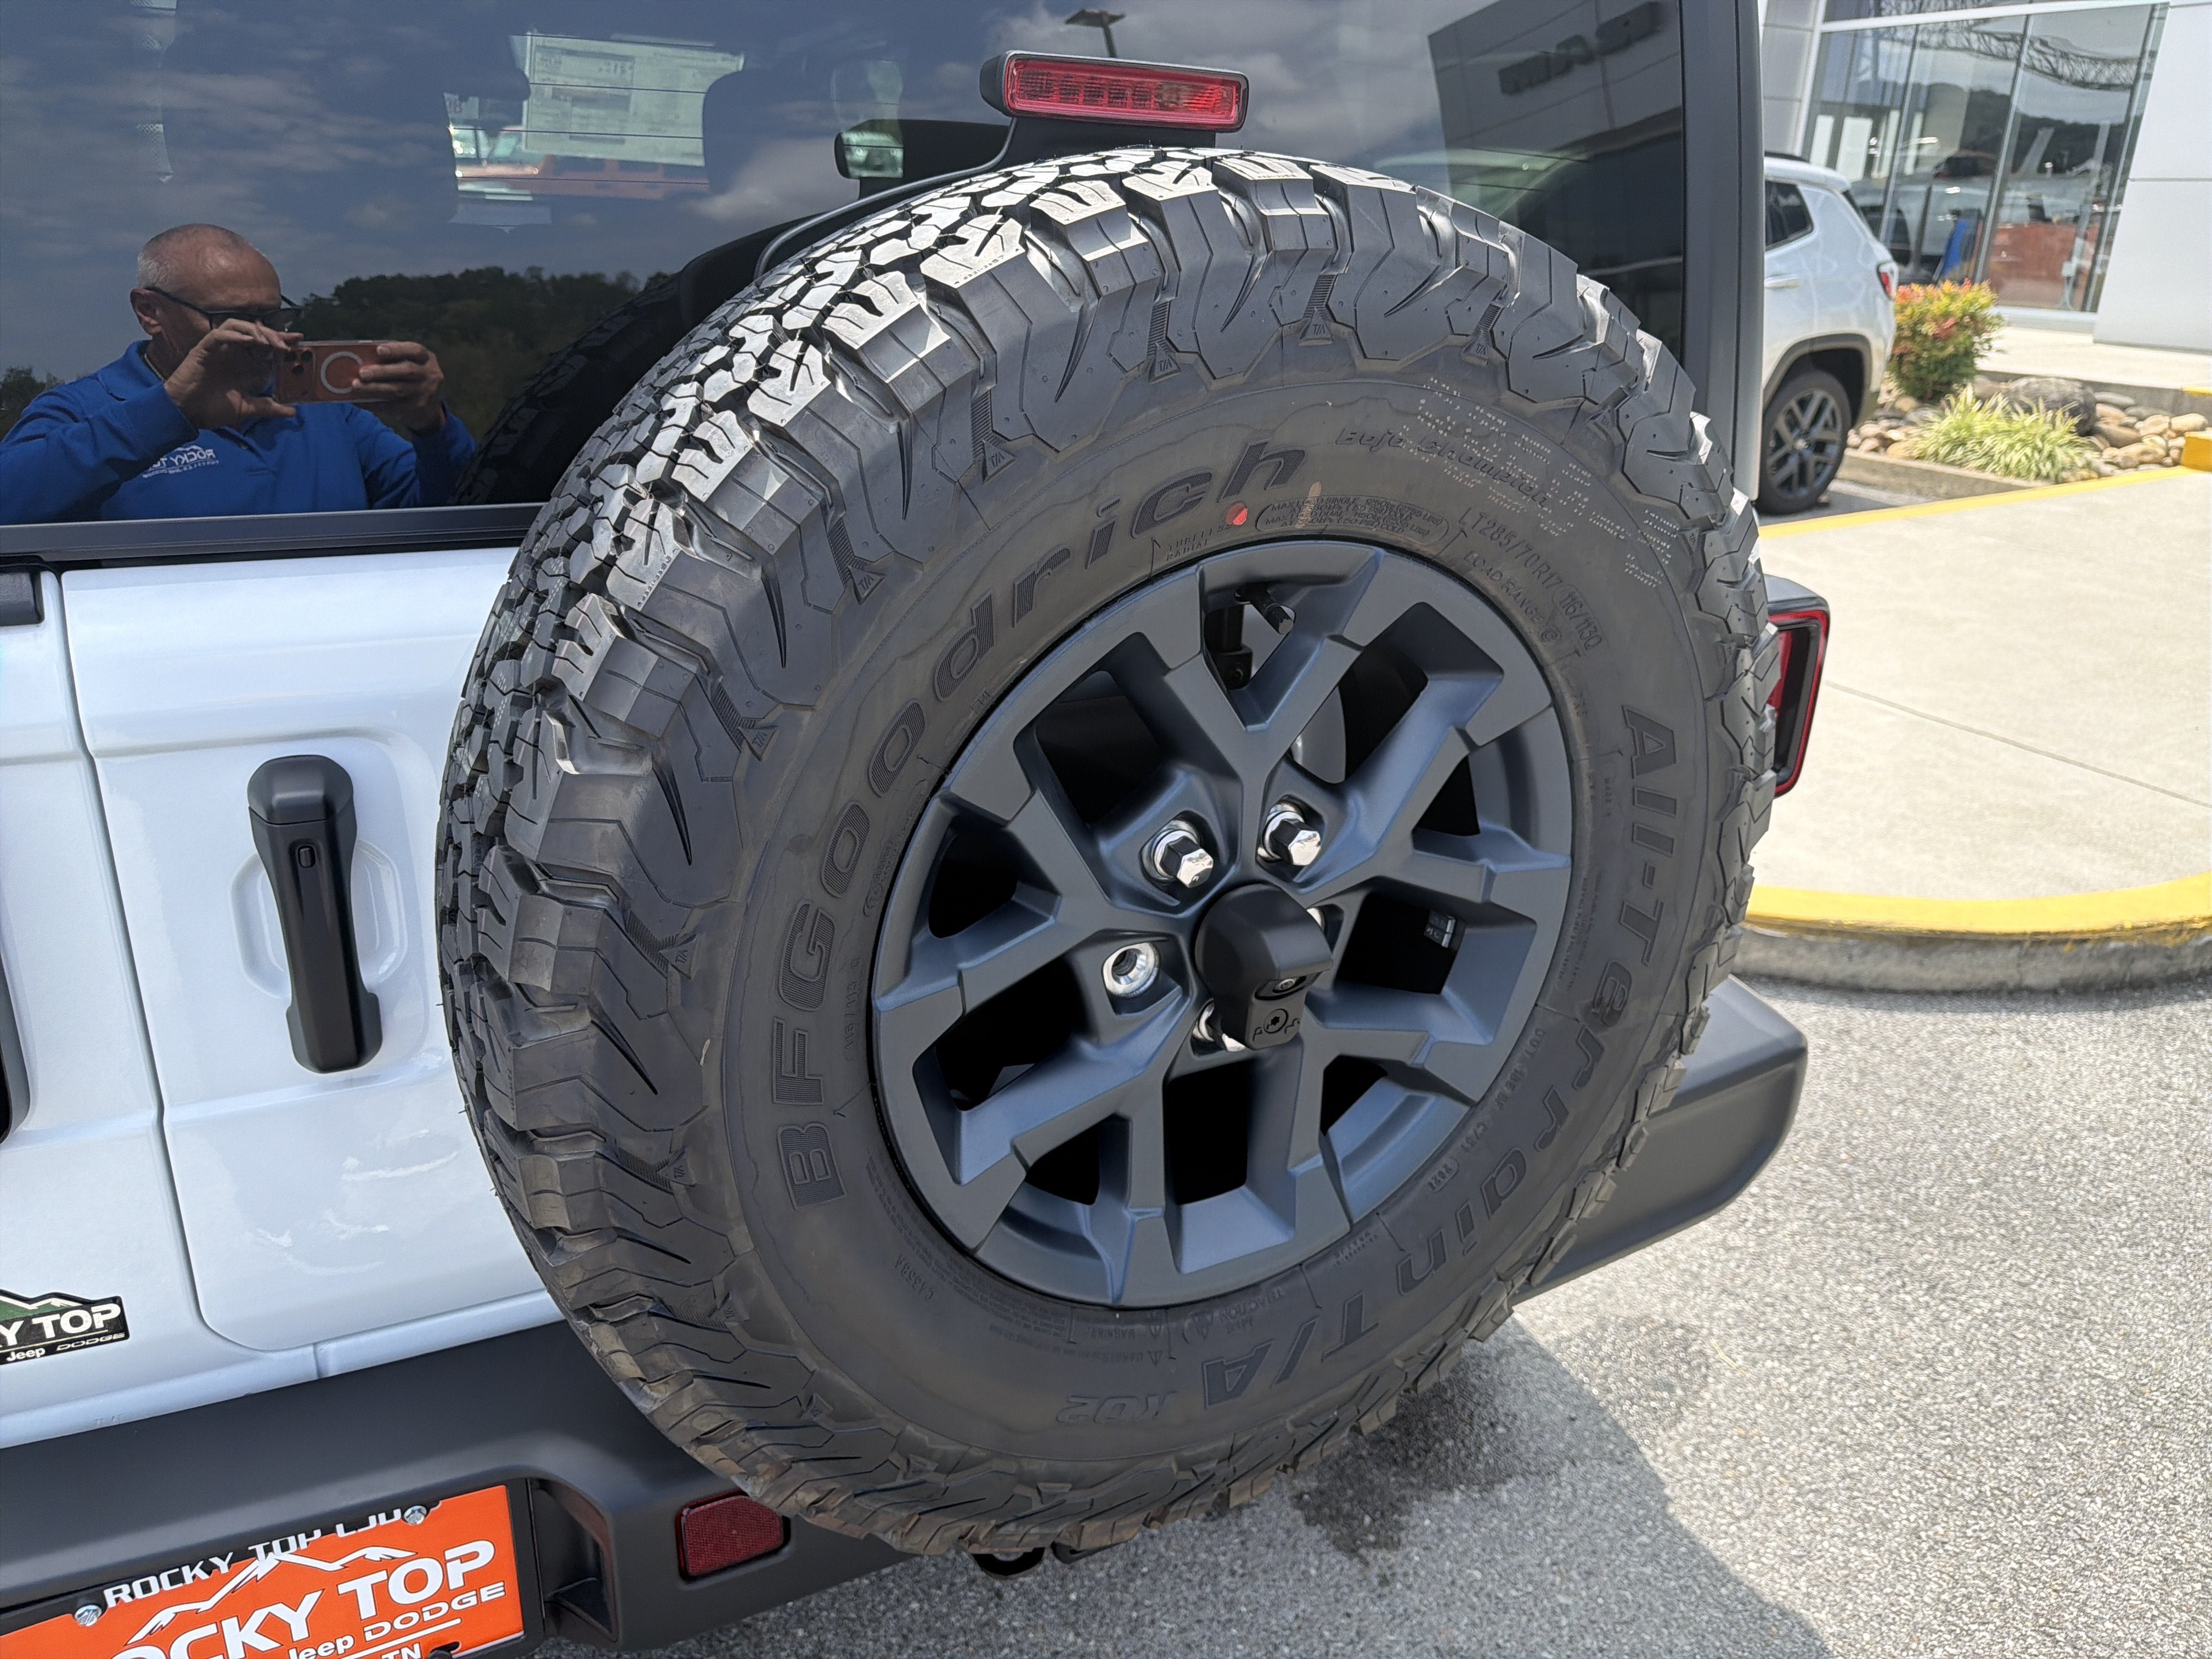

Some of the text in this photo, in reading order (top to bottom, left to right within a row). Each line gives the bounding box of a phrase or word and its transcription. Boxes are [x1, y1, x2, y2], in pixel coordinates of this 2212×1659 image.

[772, 441, 1305, 1210] BFGoodrich
[6, 1332, 126, 1362] Jeep DODGE
[31, 1303, 121, 1339] TOP
[1203, 1291, 1379, 1409] T/A
[104, 1552, 234, 1608] ROCKY
[337, 1539, 496, 1621] TOP
[363, 1582, 506, 1642] DODGE
